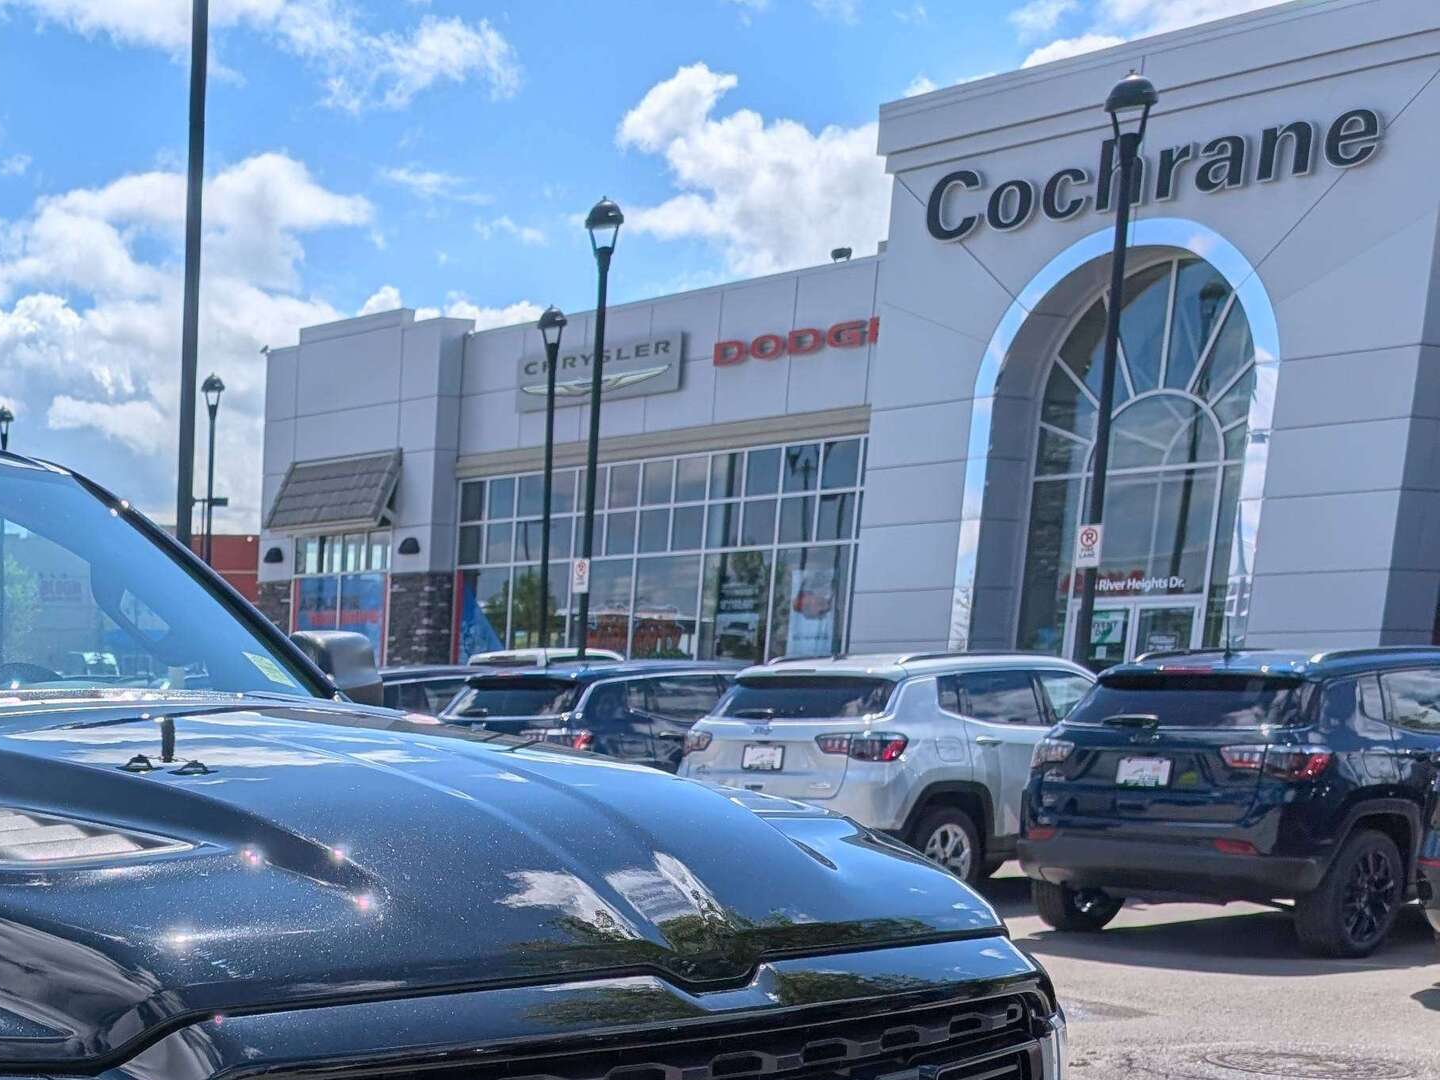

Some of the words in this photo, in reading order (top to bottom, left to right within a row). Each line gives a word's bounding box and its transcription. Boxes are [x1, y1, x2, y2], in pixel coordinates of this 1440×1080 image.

[925, 106, 1383, 243] Cochrane
[1098, 578, 1127, 592] River
[1127, 575, 1169, 592] Heights
[1169, 575, 1185, 590] Dr.
